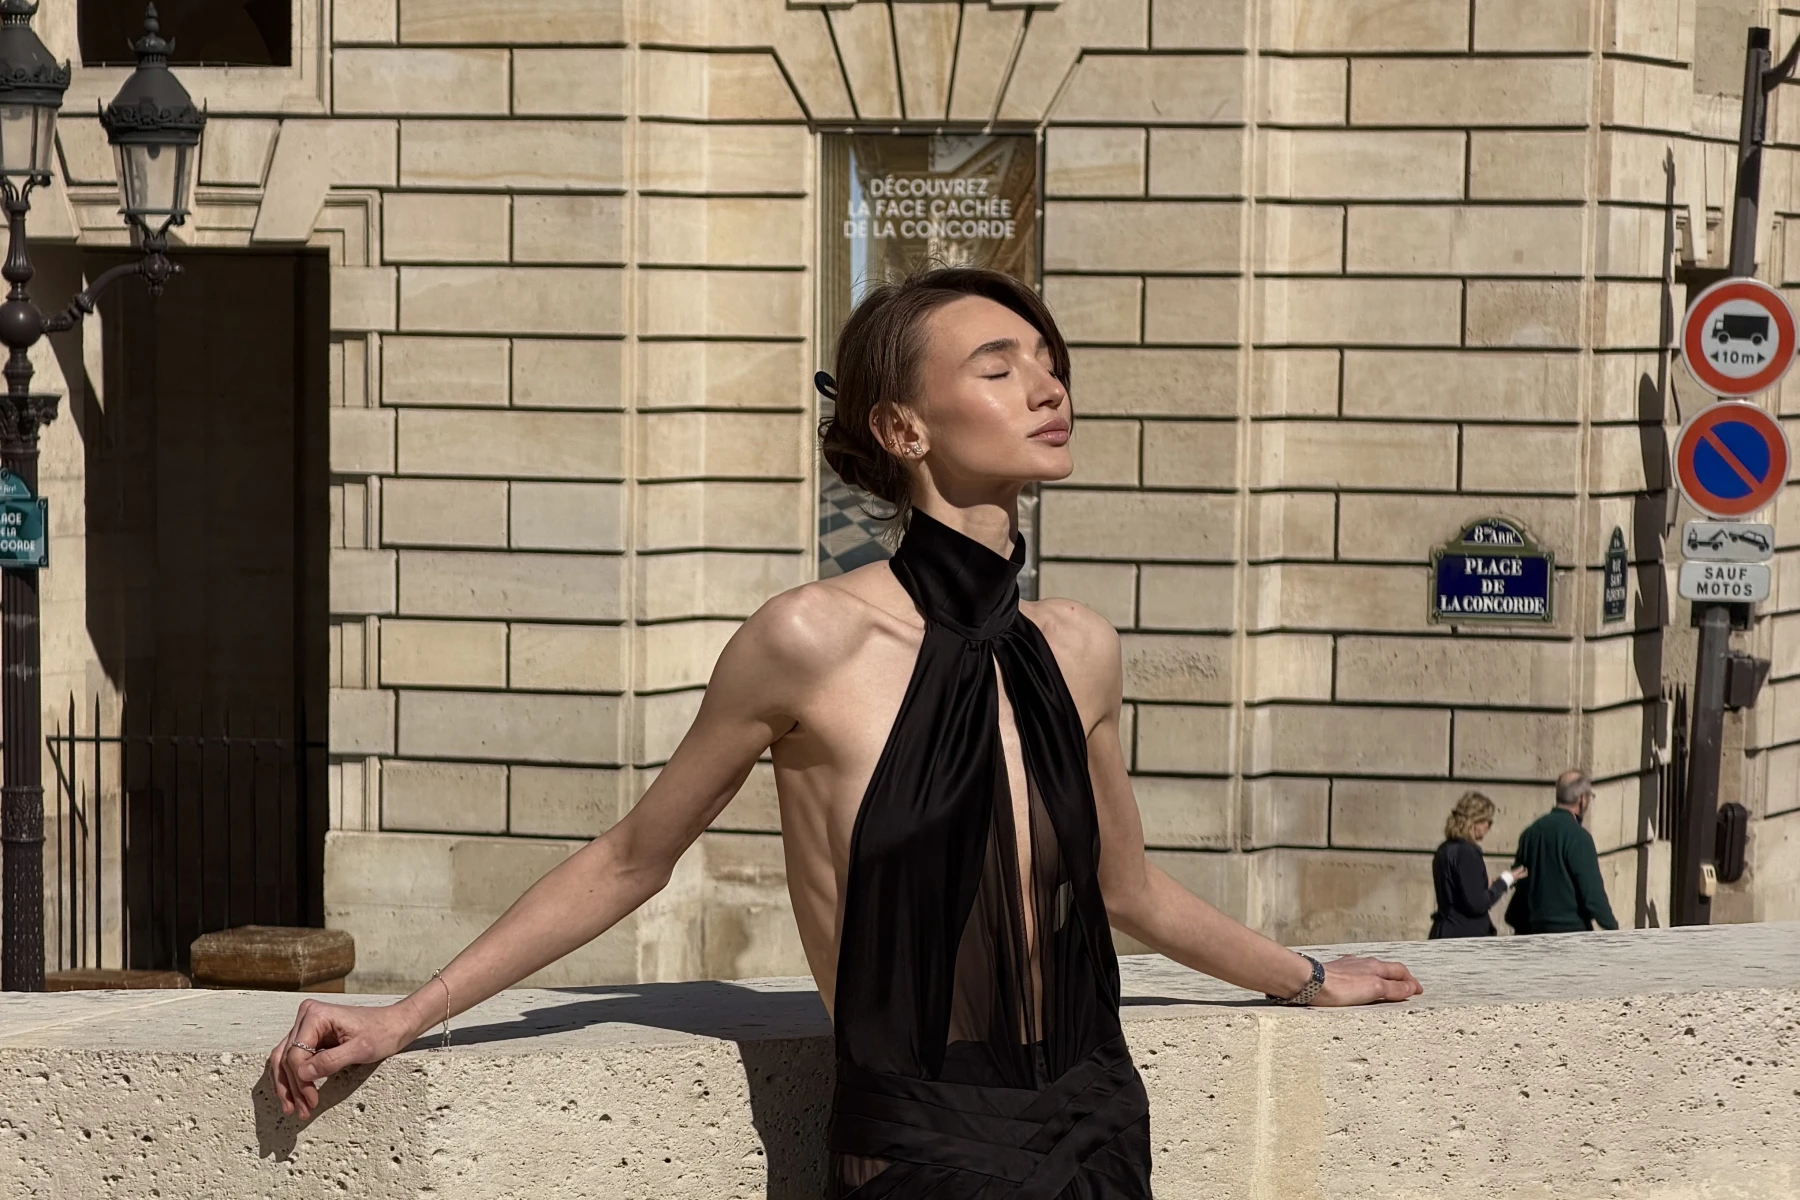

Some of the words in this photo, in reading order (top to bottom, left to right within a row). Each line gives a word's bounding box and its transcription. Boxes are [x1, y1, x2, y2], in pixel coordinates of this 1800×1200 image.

[870, 175, 989, 197] DÉCOUVREZ
[848, 200, 870, 218] LA
[875, 200, 926, 218] FACE
[930, 195, 1012, 218] CACHÉE
[844, 220, 868, 239] DE
[873, 221, 896, 239] LA
[900, 220, 1016, 239] CONCORDE
[0, 512, 22, 526] ACE
[0, 539, 36, 552] CORDE
[1464, 557, 1522, 576] PLACE
[1704, 567, 1747, 580] SAUF
[1481, 579, 1504, 595] DE
[1696, 582, 1753, 597] MOTOS
[1440, 595, 1461, 612] LA
[1463, 596, 1545, 614] CONCORDE
